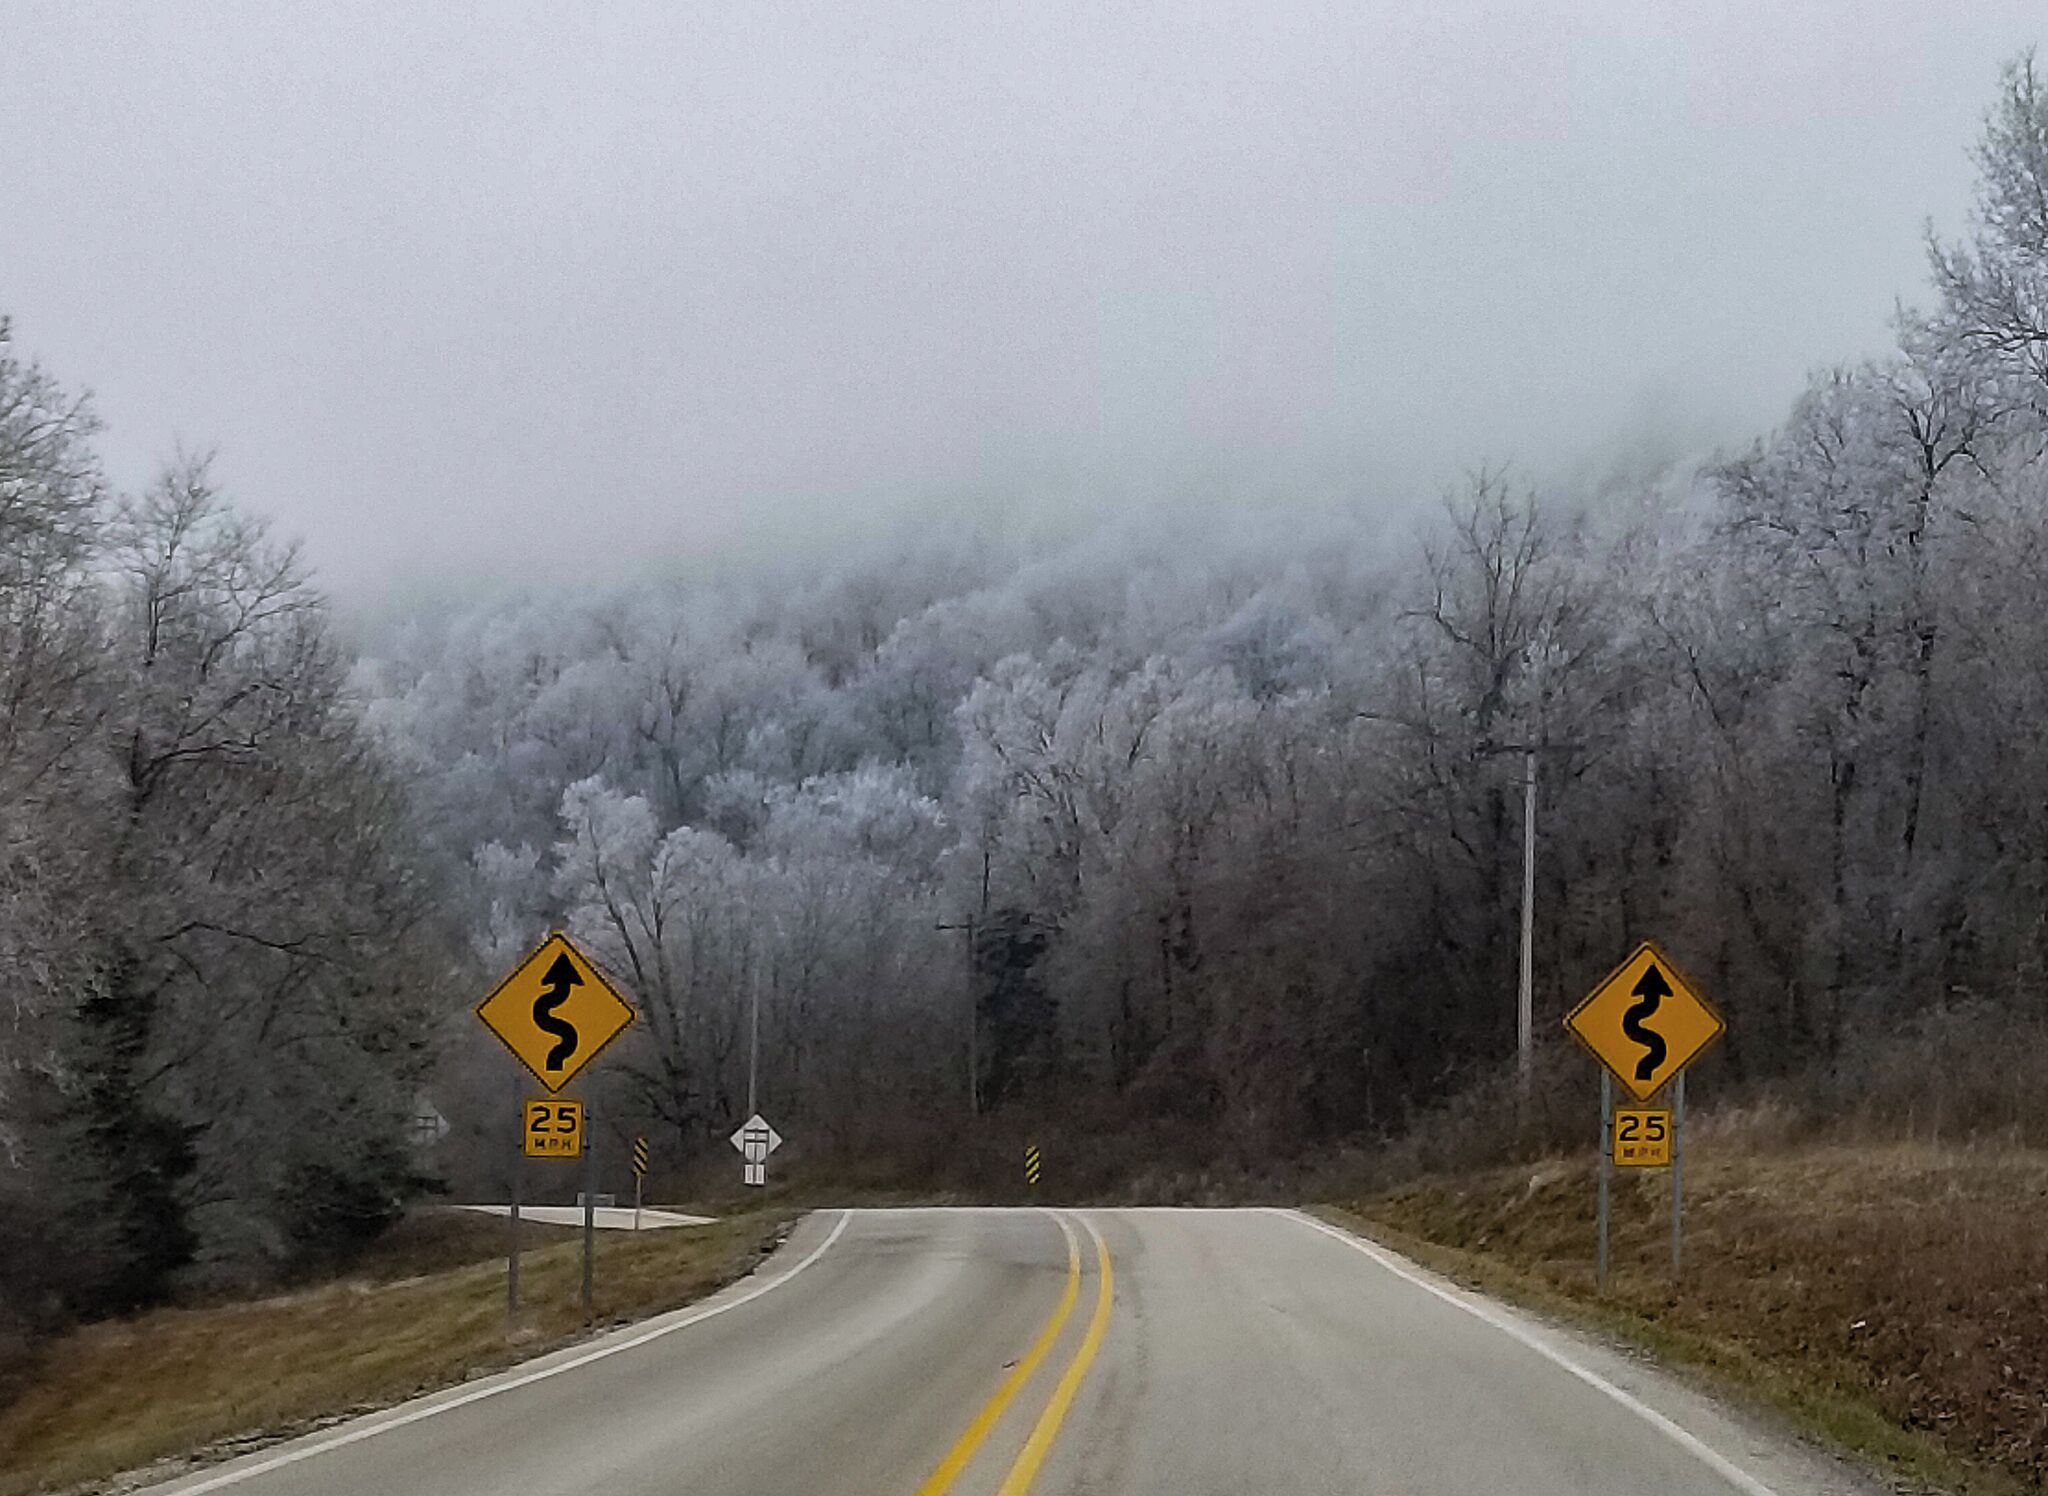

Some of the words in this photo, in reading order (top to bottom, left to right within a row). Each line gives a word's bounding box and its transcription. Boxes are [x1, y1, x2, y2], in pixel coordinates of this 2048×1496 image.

[531, 1106, 576, 1133] 25
[1620, 1116, 1665, 1141] 25
[534, 1138, 572, 1150] MPH
